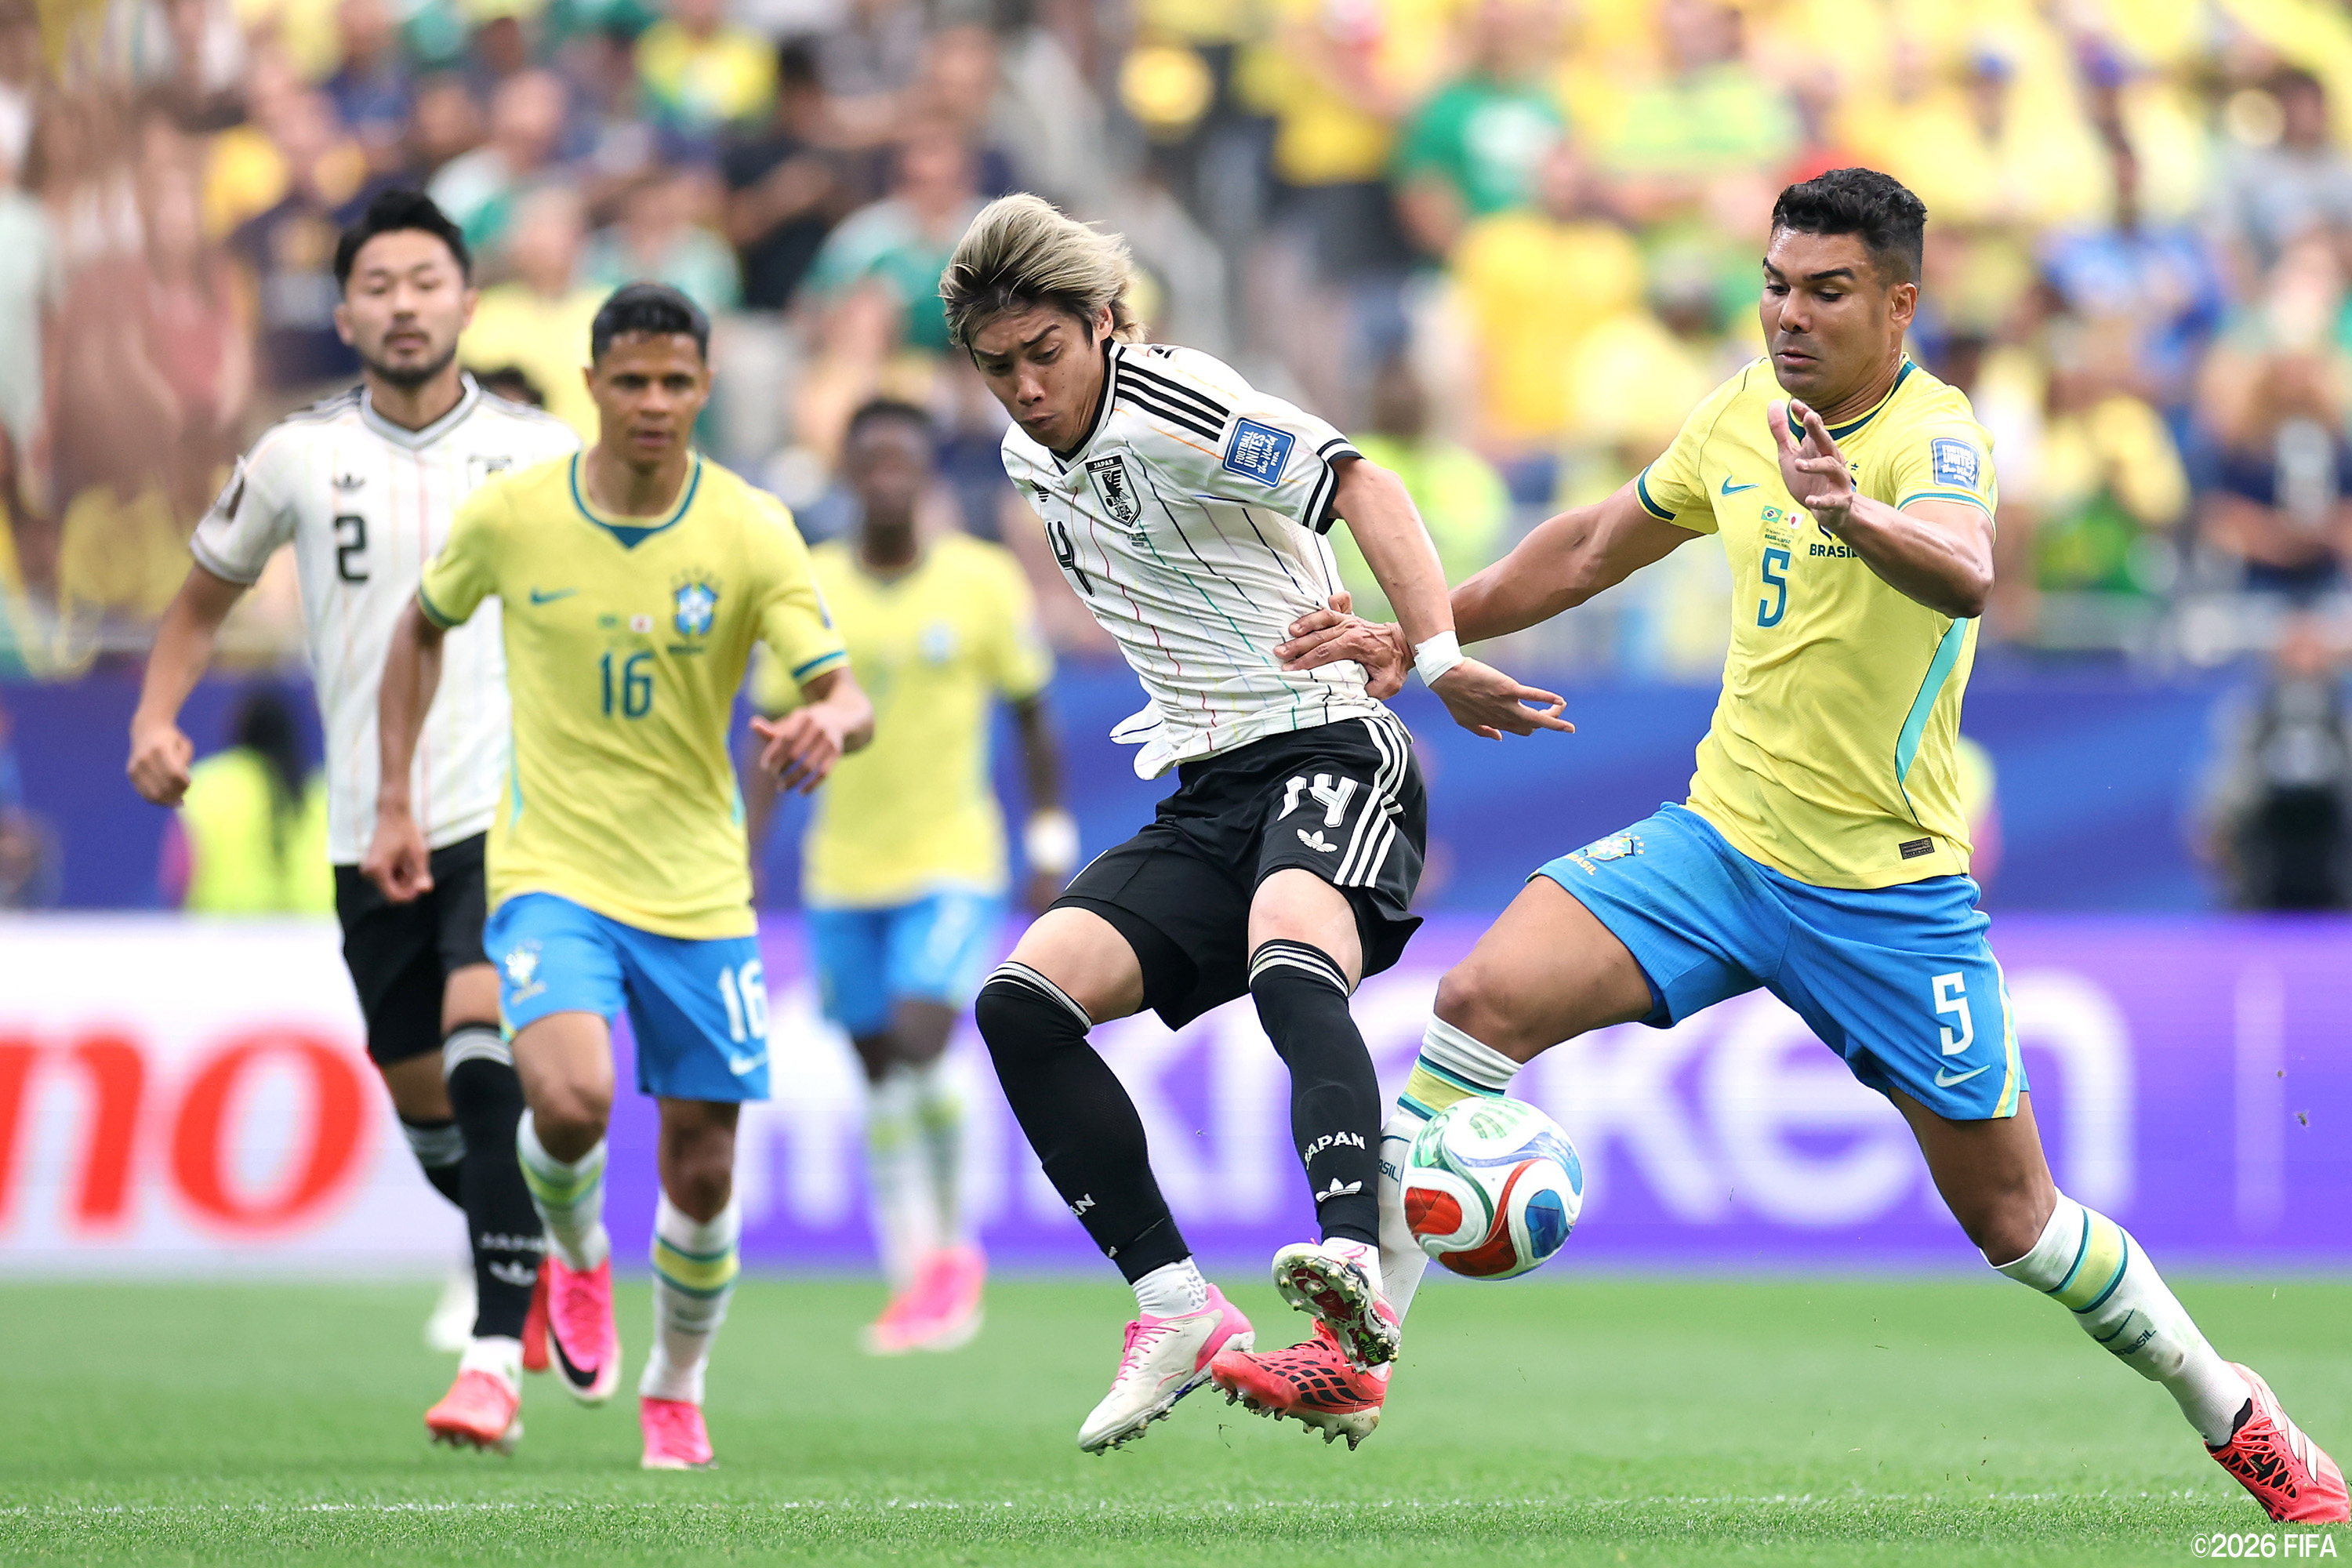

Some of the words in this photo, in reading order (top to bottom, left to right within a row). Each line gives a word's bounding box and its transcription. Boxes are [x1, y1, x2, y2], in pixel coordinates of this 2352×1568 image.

[1093, 459, 1114, 469] JAPAN
[1234, 431, 1254, 464] FOOTBALL
[1243, 433, 1266, 468] UNITES
[1260, 434, 1279, 460] World
[1270, 451, 1280, 466] FIFA
[1943, 452, 1976, 471] UNITES
[1257, 460, 1269, 474] the
[333, 514, 369, 584] 2
[1809, 543, 1860, 558] BRASIL
[1757, 547, 1791, 628] 5
[599, 650, 654, 720] 16
[1276, 773, 1359, 828] 14
[717, 960, 768, 1043] 16
[1931, 971, 1975, 1056] 5
[1305, 1131, 1365, 1171] JAPAN
